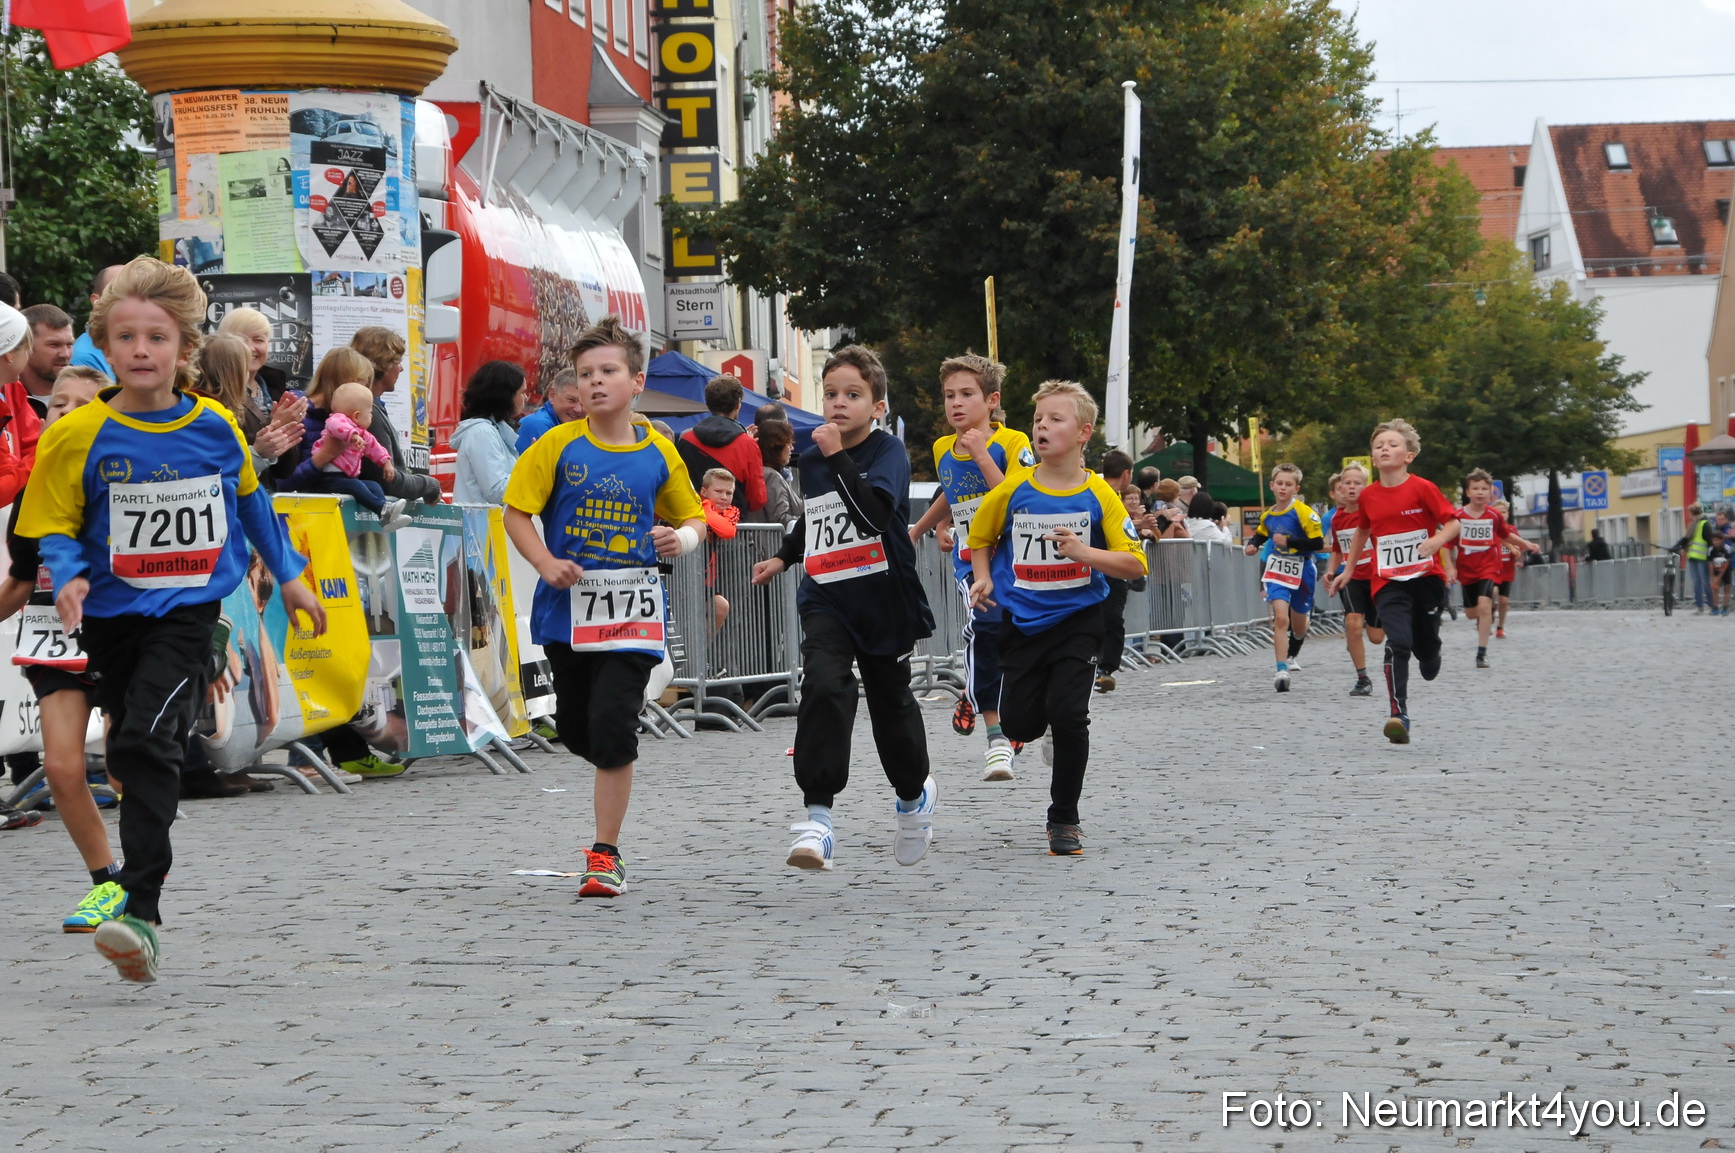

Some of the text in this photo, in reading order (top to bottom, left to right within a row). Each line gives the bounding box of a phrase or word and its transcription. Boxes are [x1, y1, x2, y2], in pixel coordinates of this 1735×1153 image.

[184, 94, 238, 104] NEUMARKTER
[174, 104, 238, 115] FRÜHLINGSFEST
[245, 106, 288, 114] FRÜHLIN
[660, 0, 716, 268] OTEL
[337, 149, 363, 160] JAZZ
[670, 287, 720, 295] Altstadthotel
[312, 304, 369, 312] Sonntagsführungen
[676, 300, 714, 311] Stern
[112, 490, 207, 504] PARTL Neumarkt
[1585, 498, 1606, 507] TAXI
[806, 505, 825, 516] PARTL
[124, 504, 215, 548] 7201
[1038, 521, 1077, 529] Neumarkt
[1464, 526, 1491, 538] 7098
[1020, 532, 1083, 560] 71
[137, 558, 208, 574] Jonathan
[1270, 558, 1299, 576] 7155
[1026, 568, 1076, 581] Benjamin
[572, 577, 645, 587] PARTL Neumarkt
[581, 589, 655, 621] 7175
[26, 615, 52, 624] PARTL
[293, 627, 314, 640] Pflaste
[599, 627, 638, 639] Fabian
[289, 648, 332, 662] Außenplatten
